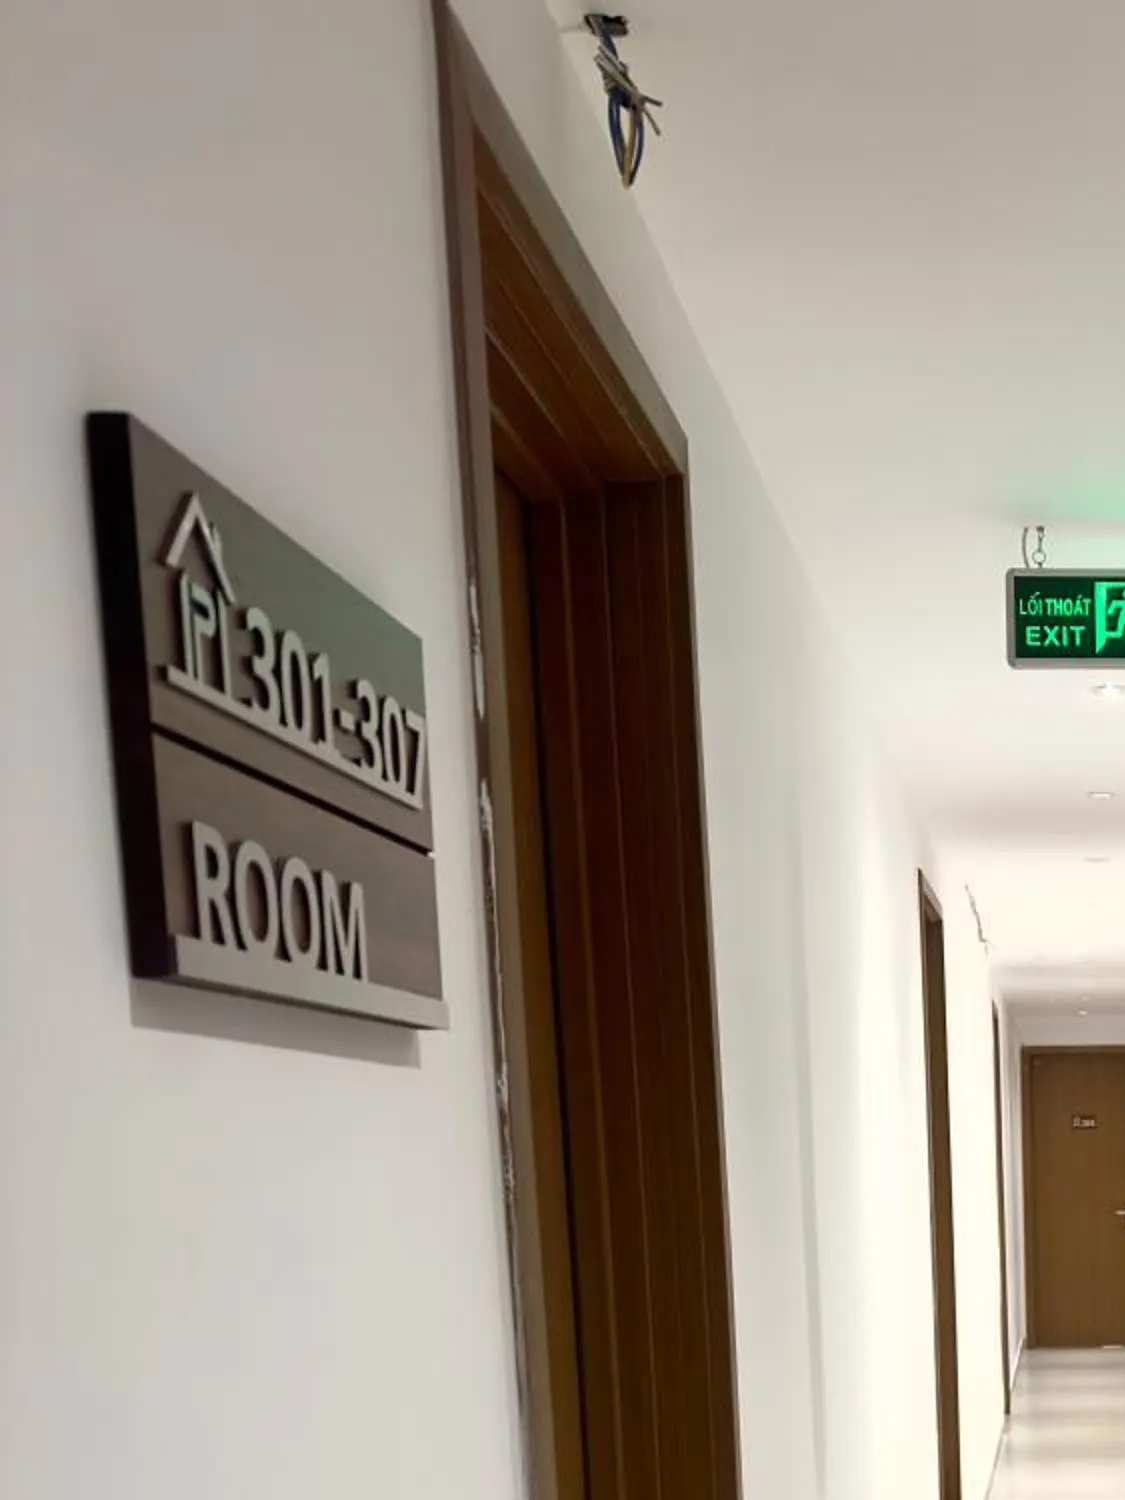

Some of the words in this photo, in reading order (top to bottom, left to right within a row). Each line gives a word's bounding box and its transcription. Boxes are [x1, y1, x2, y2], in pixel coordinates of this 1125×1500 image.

[245, 606, 427, 800] 301-307
[1025, 625, 1086, 648] EXIT
[191, 819, 368, 982] ROOM
